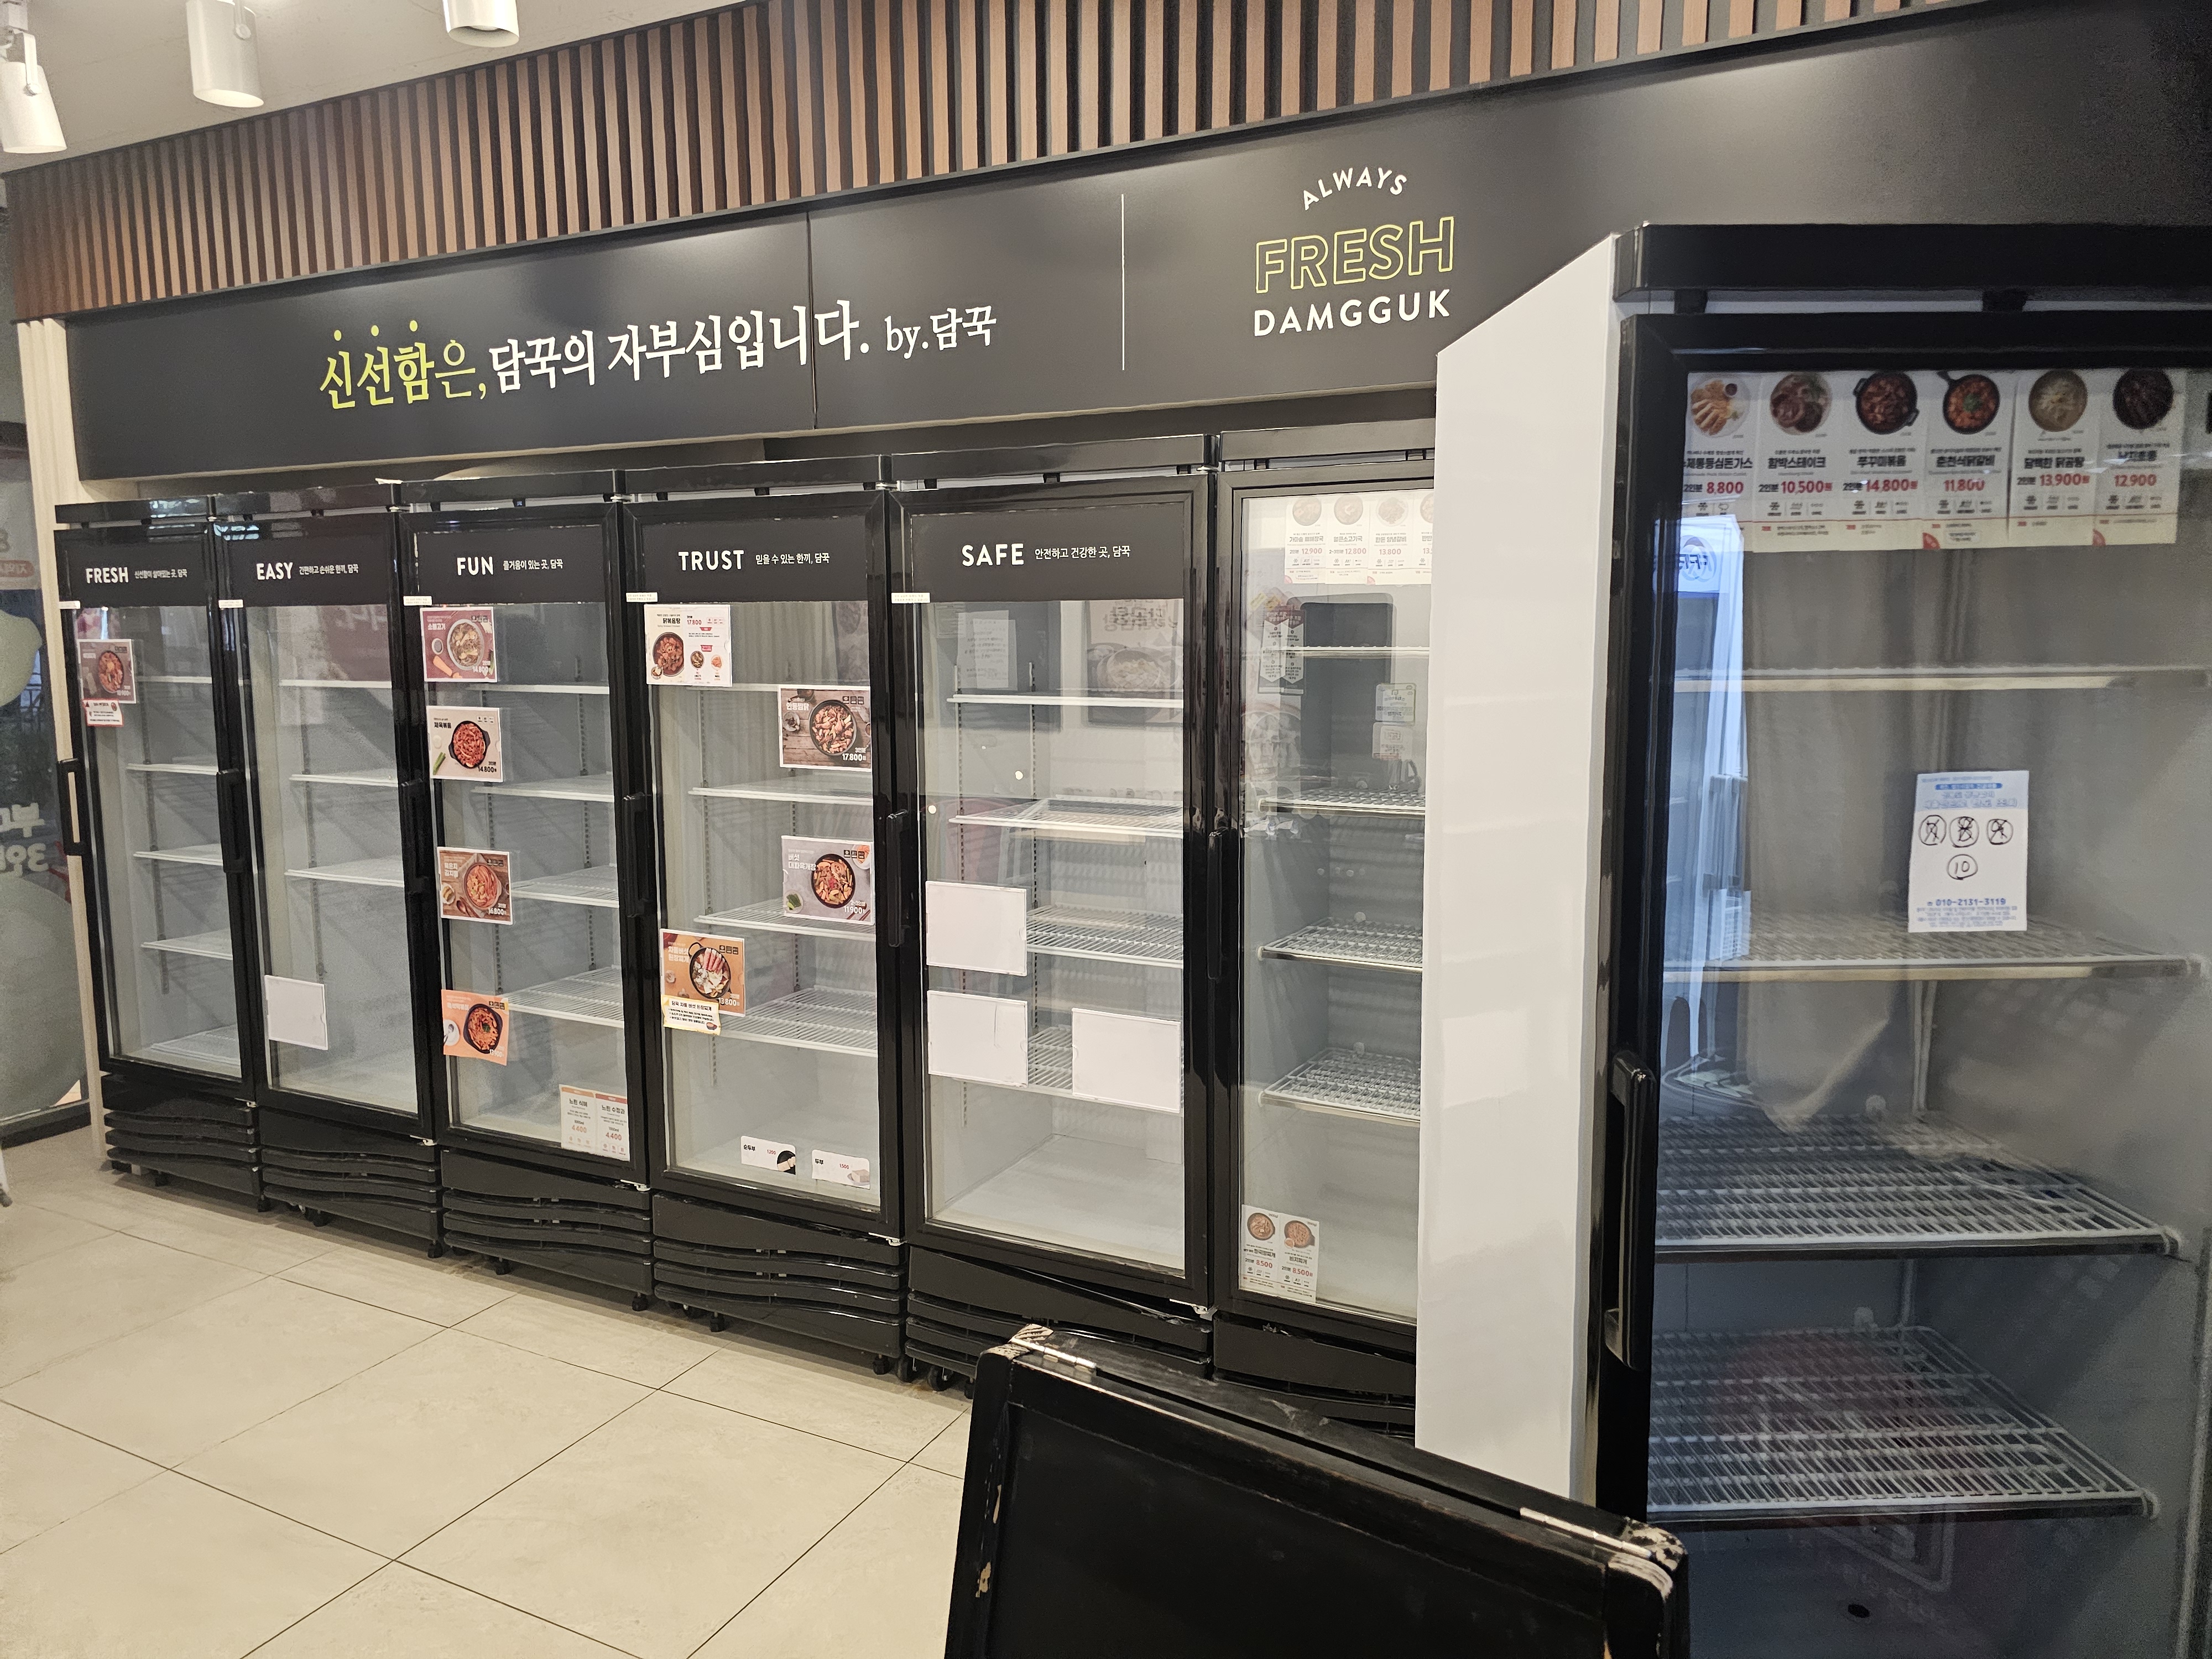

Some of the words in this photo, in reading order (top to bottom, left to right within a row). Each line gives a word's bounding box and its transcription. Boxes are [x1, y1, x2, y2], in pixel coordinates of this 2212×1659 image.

[1303, 167, 1407, 211] ALWAYS
[1256, 216, 1454, 294] FRESH
[1254, 289, 1450, 336] DAMGGUK
[320, 338, 487, 409] 신선함은,
[489, 330, 595, 394] 담꾹의
[608, 299, 869, 382] 자부심입니다.
[1768, 456, 1827, 469] 함박스테이크
[1706, 481, 1744, 494] 8,800
[755, 554, 770, 565] 믿을
[771, 554, 780, 564] 수
[780, 553, 795, 564] 있는
[796, 552, 813, 565] 한끼,
[814, 552, 830, 564] 담꾹
[962, 543, 1025, 567] SAFE
[1034, 547, 1069, 560] 안전하고
[1070, 546, 1097, 559] 건강한
[1098, 546, 1110, 559] 곳,
[1112, 545, 1131, 558] 담꾹
[457, 556, 494, 576] FUN
[503, 560, 527, 571] 즐거움이
[528, 560, 540, 570] 있는
[541, 559, 550, 570] 곳,
[550, 559, 564, 569] 담꾹
[678, 550, 744, 571] TRUST
[86, 567, 129, 583] FRESH
[256, 562, 293, 580] EASY
[299, 566, 319, 575] 간편하고
[320, 565, 335, 575] 손쉬운
[347, 564, 359, 573] 담꾹
[788, 853, 800, 862] 버섯
[788, 861, 817, 872] 대파육개장
[1954, 860, 1970, 875] 10
[1936, 898, 2006, 906] 010-2131-3119
[612, 1107, 625, 1115] 수정과
[1256, 1259, 1273, 1269] 8,500
